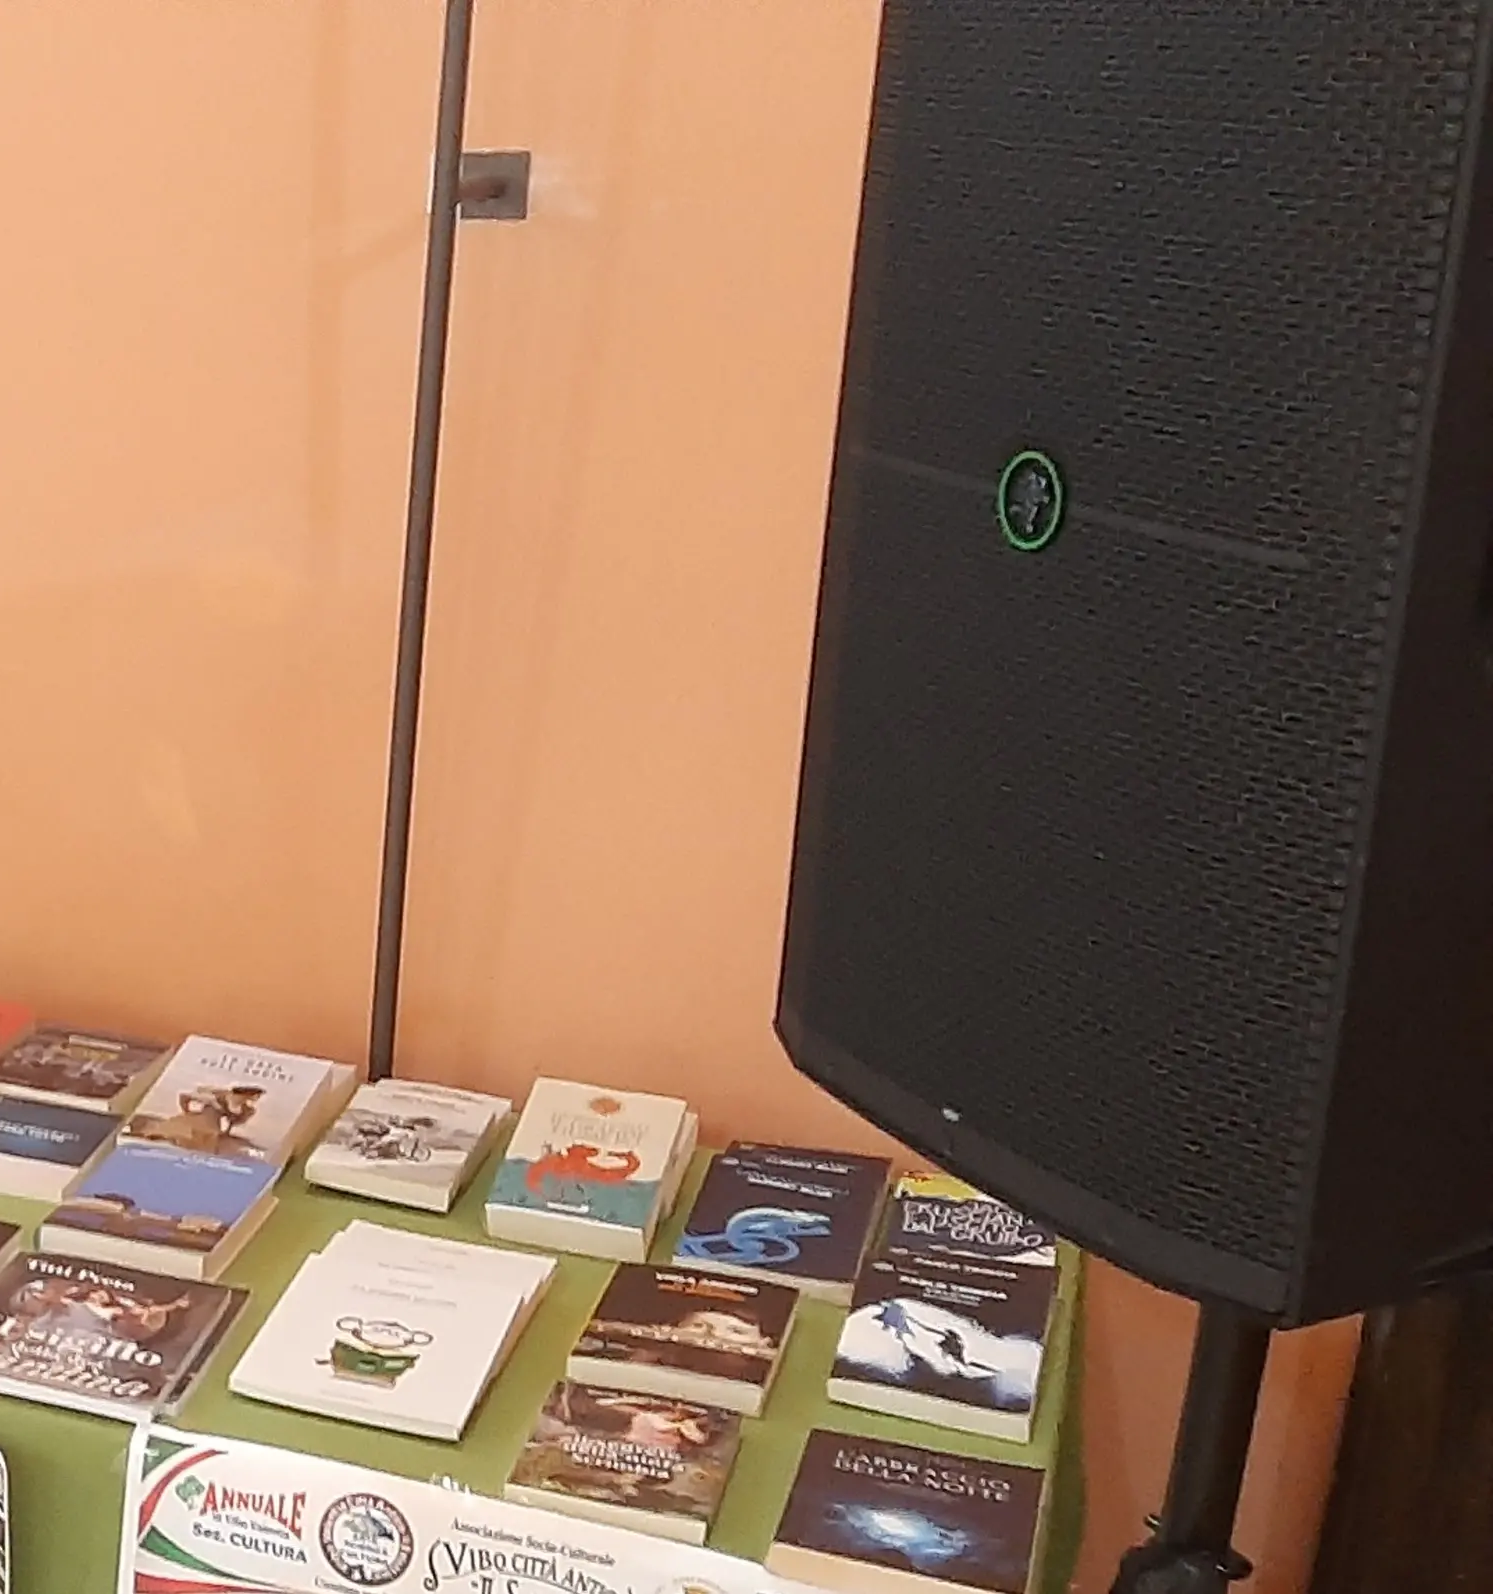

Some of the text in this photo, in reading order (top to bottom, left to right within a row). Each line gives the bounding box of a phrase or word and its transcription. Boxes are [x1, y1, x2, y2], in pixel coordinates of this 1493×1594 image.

[198, 1480, 307, 1542] ANNUALE
[228, 1532, 308, 1565] CULTURA
[443, 1541, 507, 1576] VIBO
